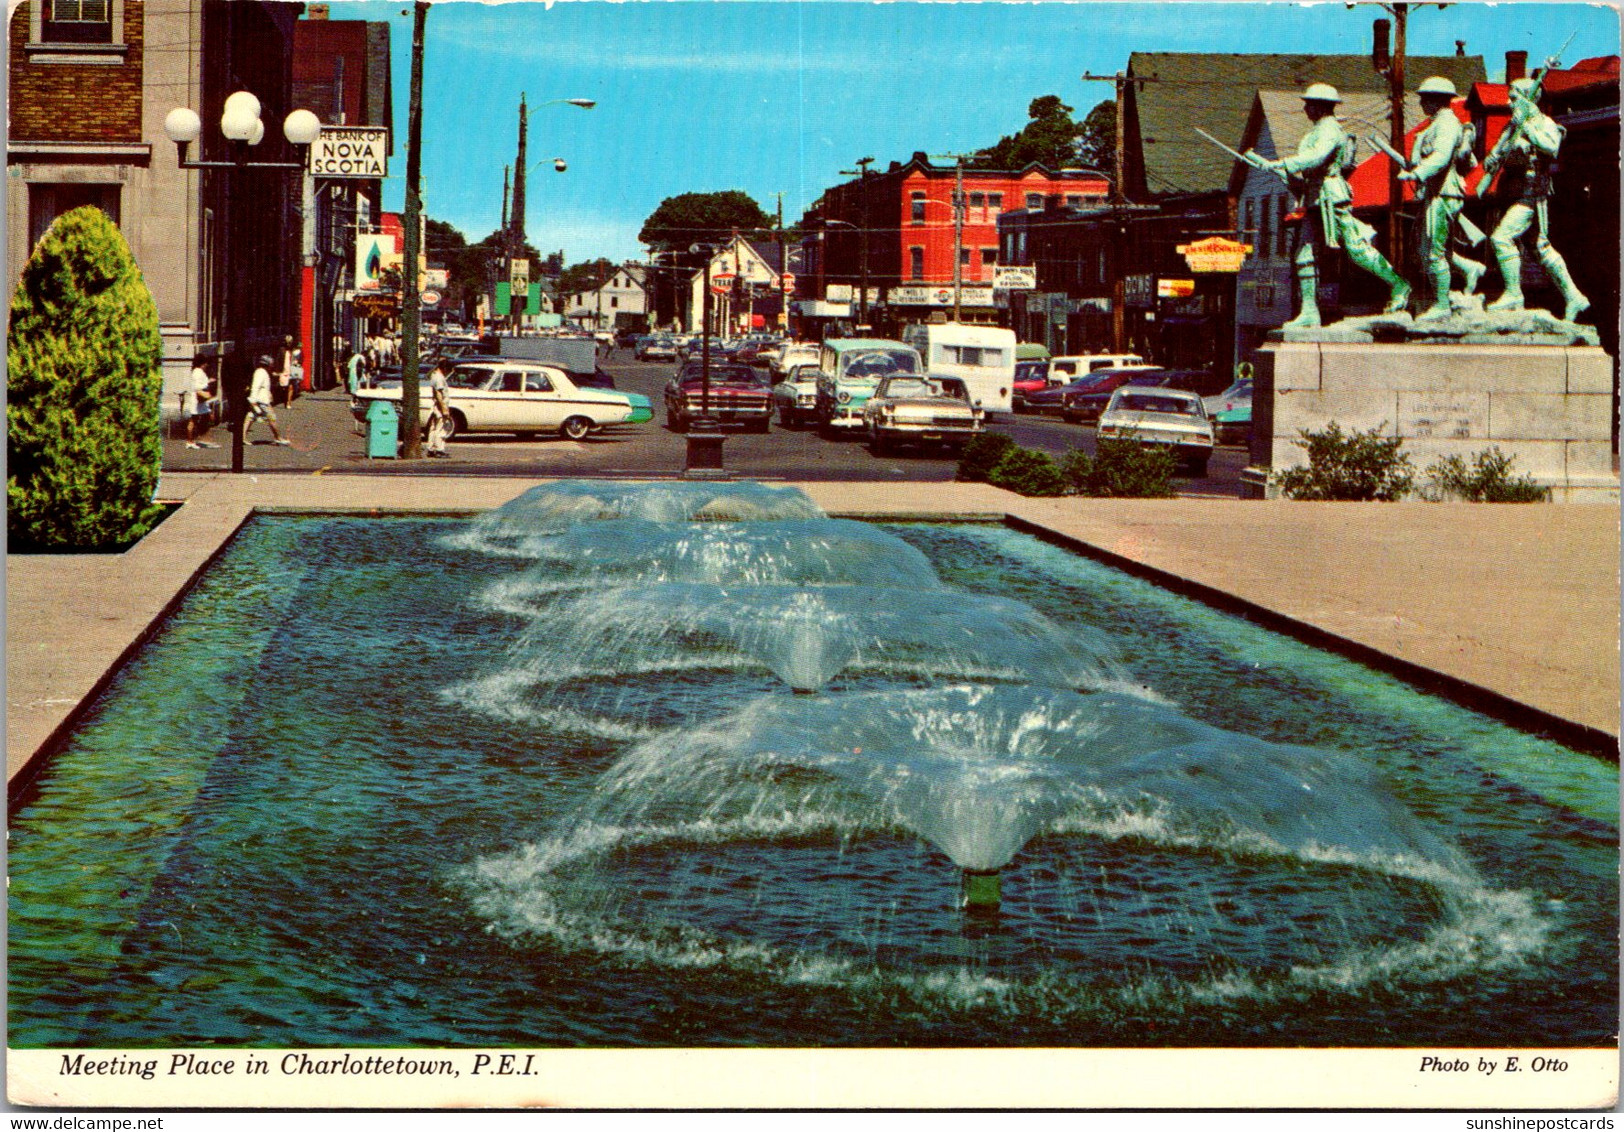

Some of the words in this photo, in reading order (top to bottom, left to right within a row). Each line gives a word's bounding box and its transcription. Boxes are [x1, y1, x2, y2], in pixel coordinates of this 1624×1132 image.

[319, 132, 333, 141] HE
[336, 132, 365, 141] BANK
[367, 132, 382, 142] OF
[323, 143, 374, 158] NOVA
[315, 159, 382, 173] SCOTIA
